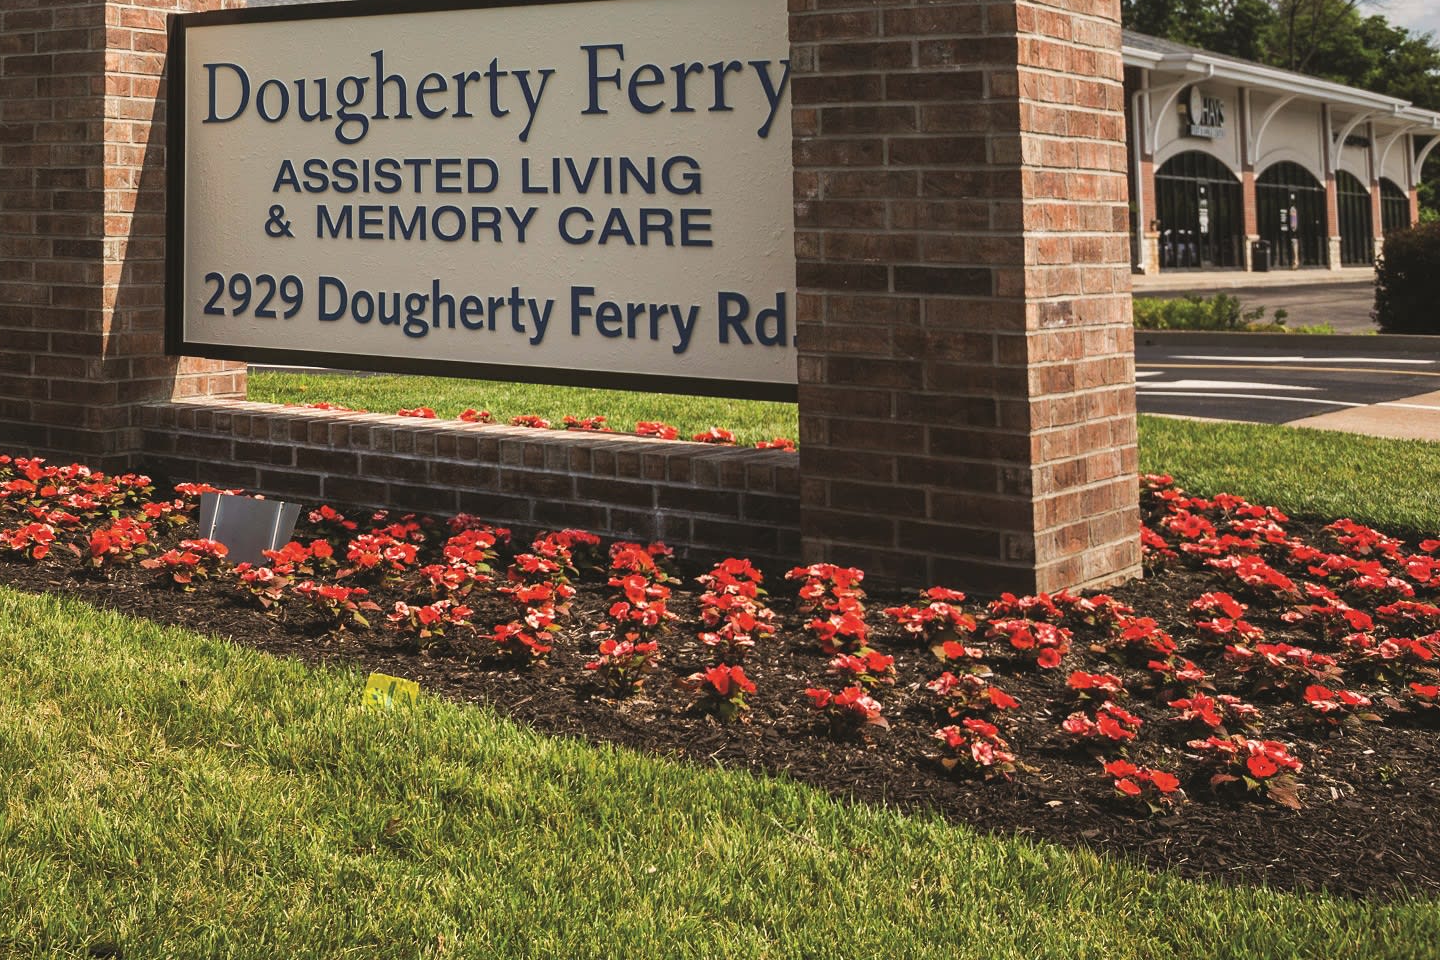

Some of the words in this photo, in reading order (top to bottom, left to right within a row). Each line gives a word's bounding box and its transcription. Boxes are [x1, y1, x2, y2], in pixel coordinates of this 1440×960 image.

[202, 49, 556, 145] Dougherty
[580, 43, 793, 138] Ferry
[272, 158, 499, 194] ASSISTED
[521, 155, 702, 196] LIVING
[264, 204, 293, 239] &
[316, 204, 537, 243] MEMORY
[558, 206, 713, 248] CARE
[203, 271, 304, 320] 2929
[318, 276, 555, 346] Dougherty
[570, 286, 700, 354] Ferry
